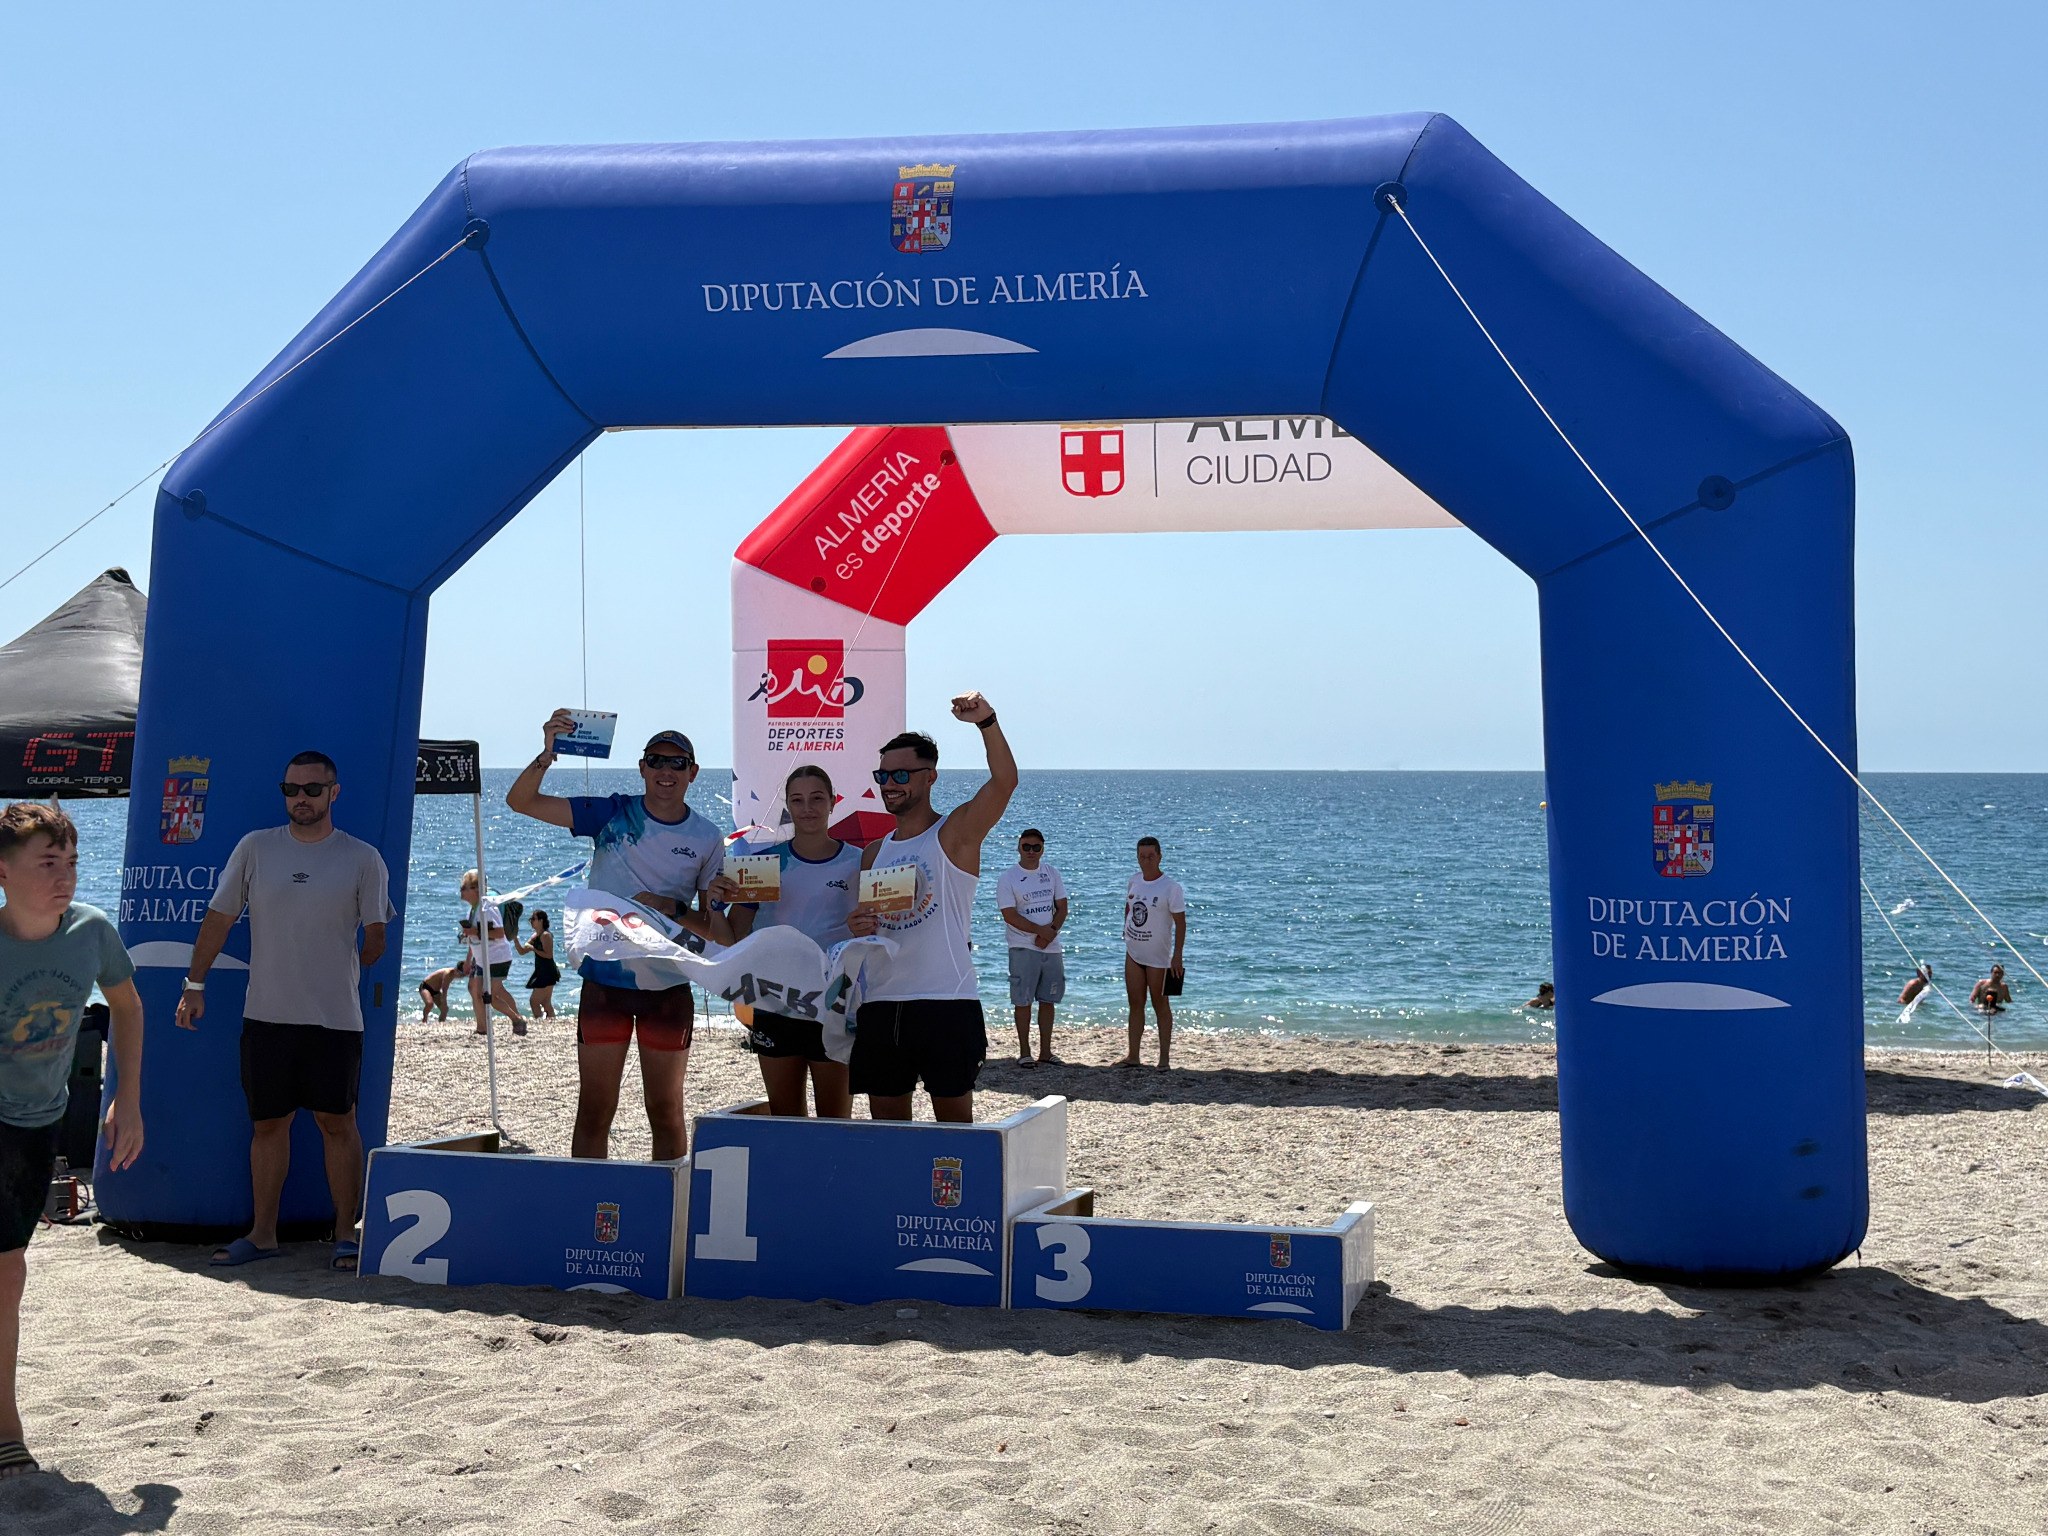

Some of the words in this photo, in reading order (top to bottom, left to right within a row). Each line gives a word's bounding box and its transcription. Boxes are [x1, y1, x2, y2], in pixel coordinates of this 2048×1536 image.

[701, 273, 920, 312] DIPUTACIÓN
[932, 276, 979, 306] DE
[988, 262, 1148, 304] ALMERÍA
[1186, 452, 1332, 485] CIUDAD
[814, 451, 920, 561] ALMERÍA
[835, 552, 863, 580] es
[861, 473, 941, 554] deporte
[768, 728, 844, 739] DEPORTES
[768, 741, 783, 751] DE
[787, 741, 844, 751] ALMERIA
[22, 731, 135, 772] GT
[26, 776, 123, 785] GLOBAL-TEMPO
[123, 866, 222, 891] DIPUTACI
[120, 899, 135, 923] DE
[138, 899, 250, 924] ALMEA
[1588, 892, 1791, 927] DIPUTACIÓN
[1592, 931, 1627, 959] DE
[1635, 928, 1788, 962] ALMERÍA
[694, 1145, 758, 1262] 1
[896, 1214, 996, 1234] DIPUTACIÓN
[378, 1189, 451, 1286] 2
[897, 1232, 918, 1248] DE
[922, 1232, 993, 1252] ALMERÍA
[565, 1247, 645, 1264] DIPUTACIÓN
[1035, 1223, 1092, 1303] 3
[566, 1262, 583, 1275] DE
[585, 1262, 642, 1278] ALMERÍA
[1245, 1272, 1316, 1286] DIPUTACIÓN
[1247, 1284, 1262, 1296] DE
[1264, 1283, 1314, 1298] ALMERÍA
